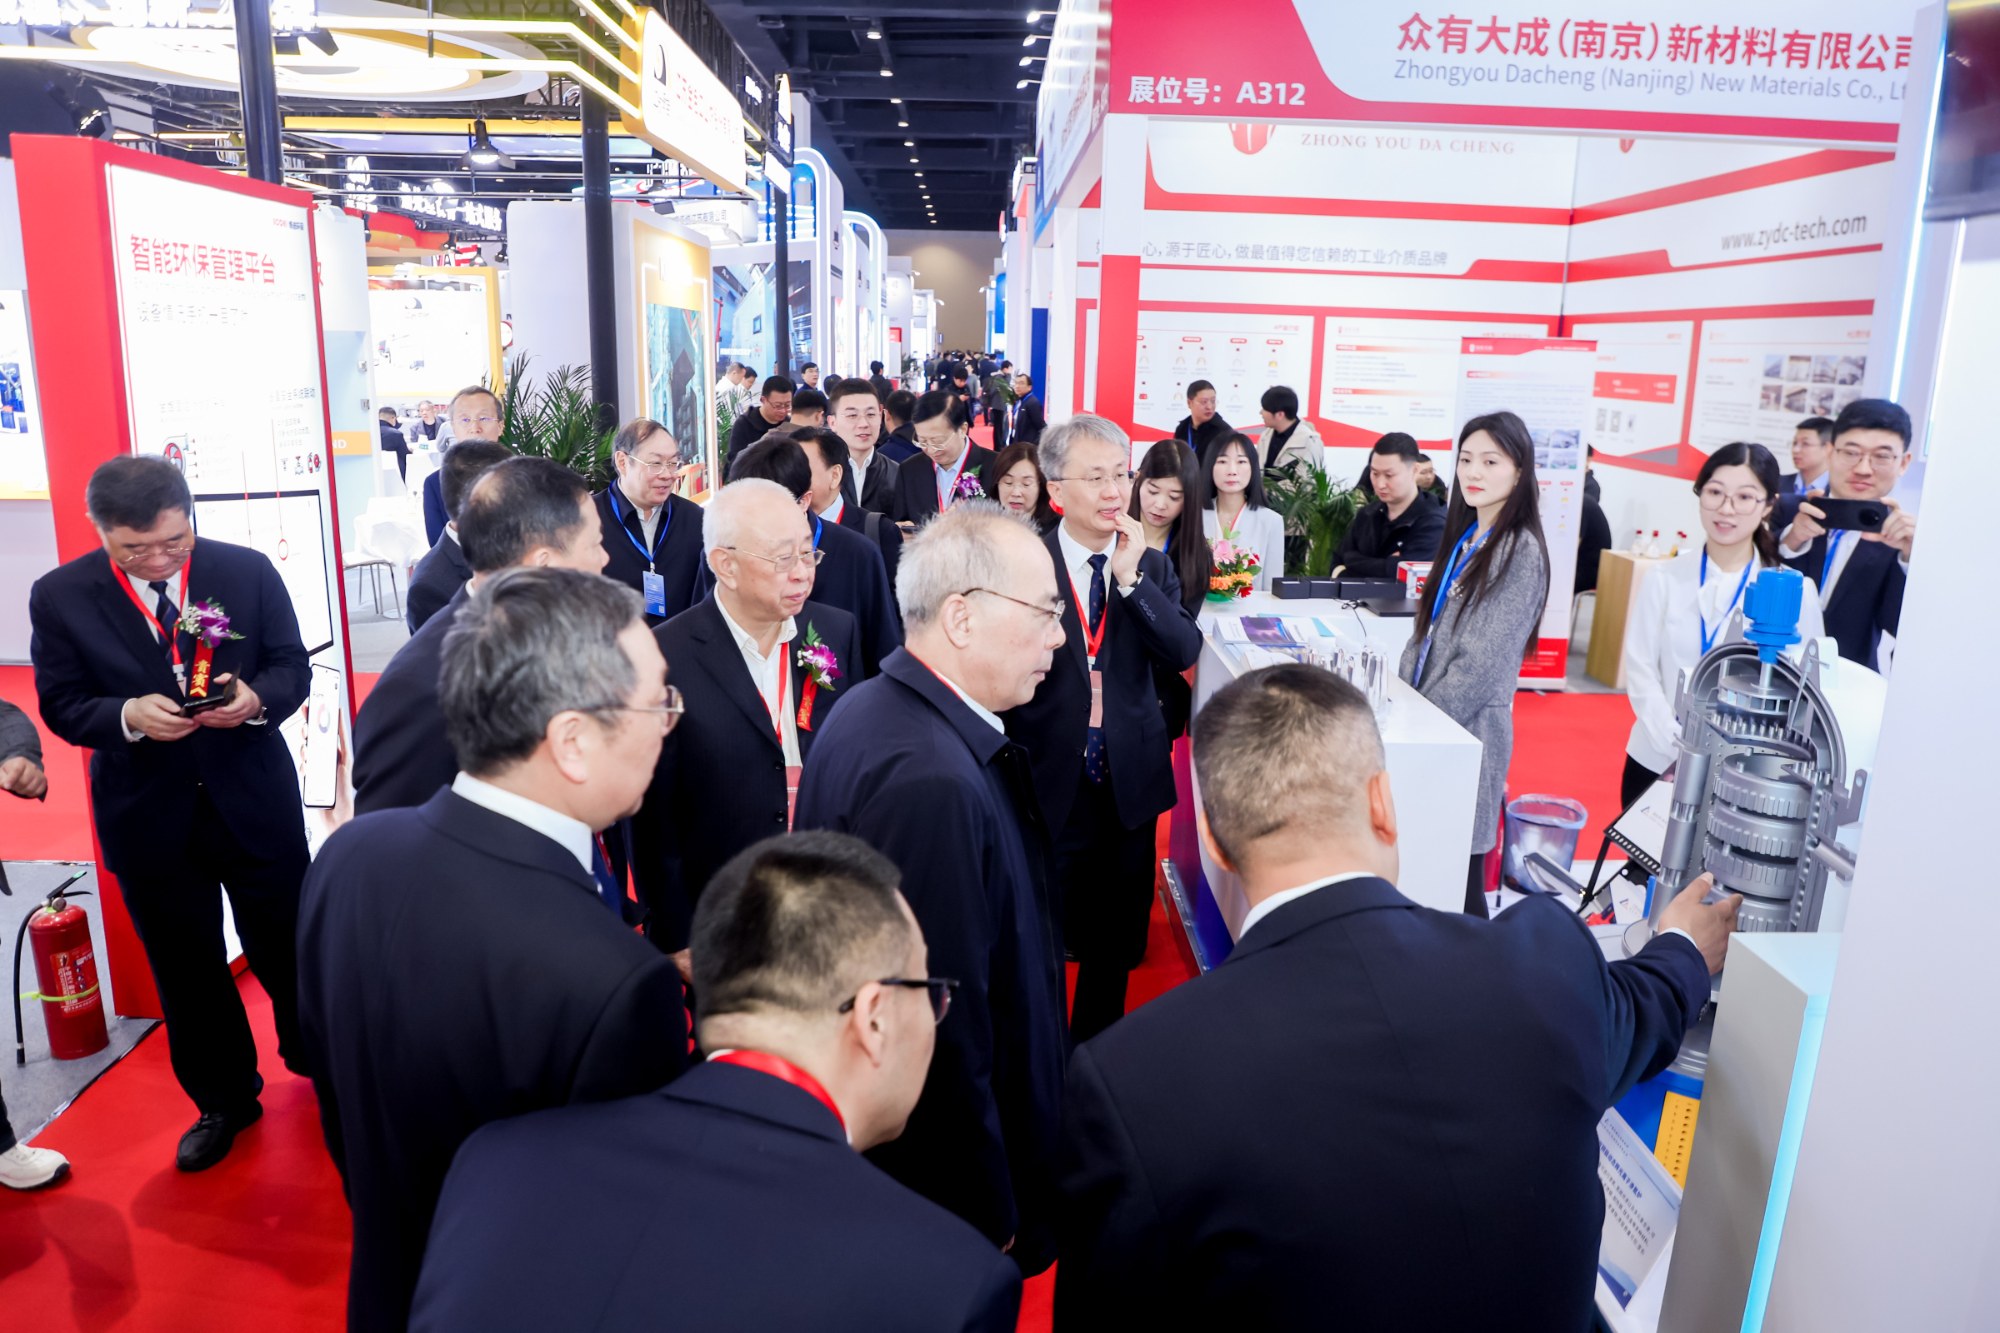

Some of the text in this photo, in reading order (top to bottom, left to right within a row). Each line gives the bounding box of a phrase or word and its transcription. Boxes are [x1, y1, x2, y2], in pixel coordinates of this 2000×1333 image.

[1394, 59, 1499, 86] Zhongyou
[1506, 63, 1595, 91] Dacheng
[1602, 66, 1694, 95] (Nanjing)
[1700, 73, 1744, 92] New
[1750, 75, 1841, 98] Materials
[1846, 80, 1884, 103] Co.,
[1301, 133, 1514, 154] ZHONG YOU DA CHENG
[1721, 215, 1867, 250] www.zydc-tech.com
[130, 233, 275, 284] 智能环保管理平台
